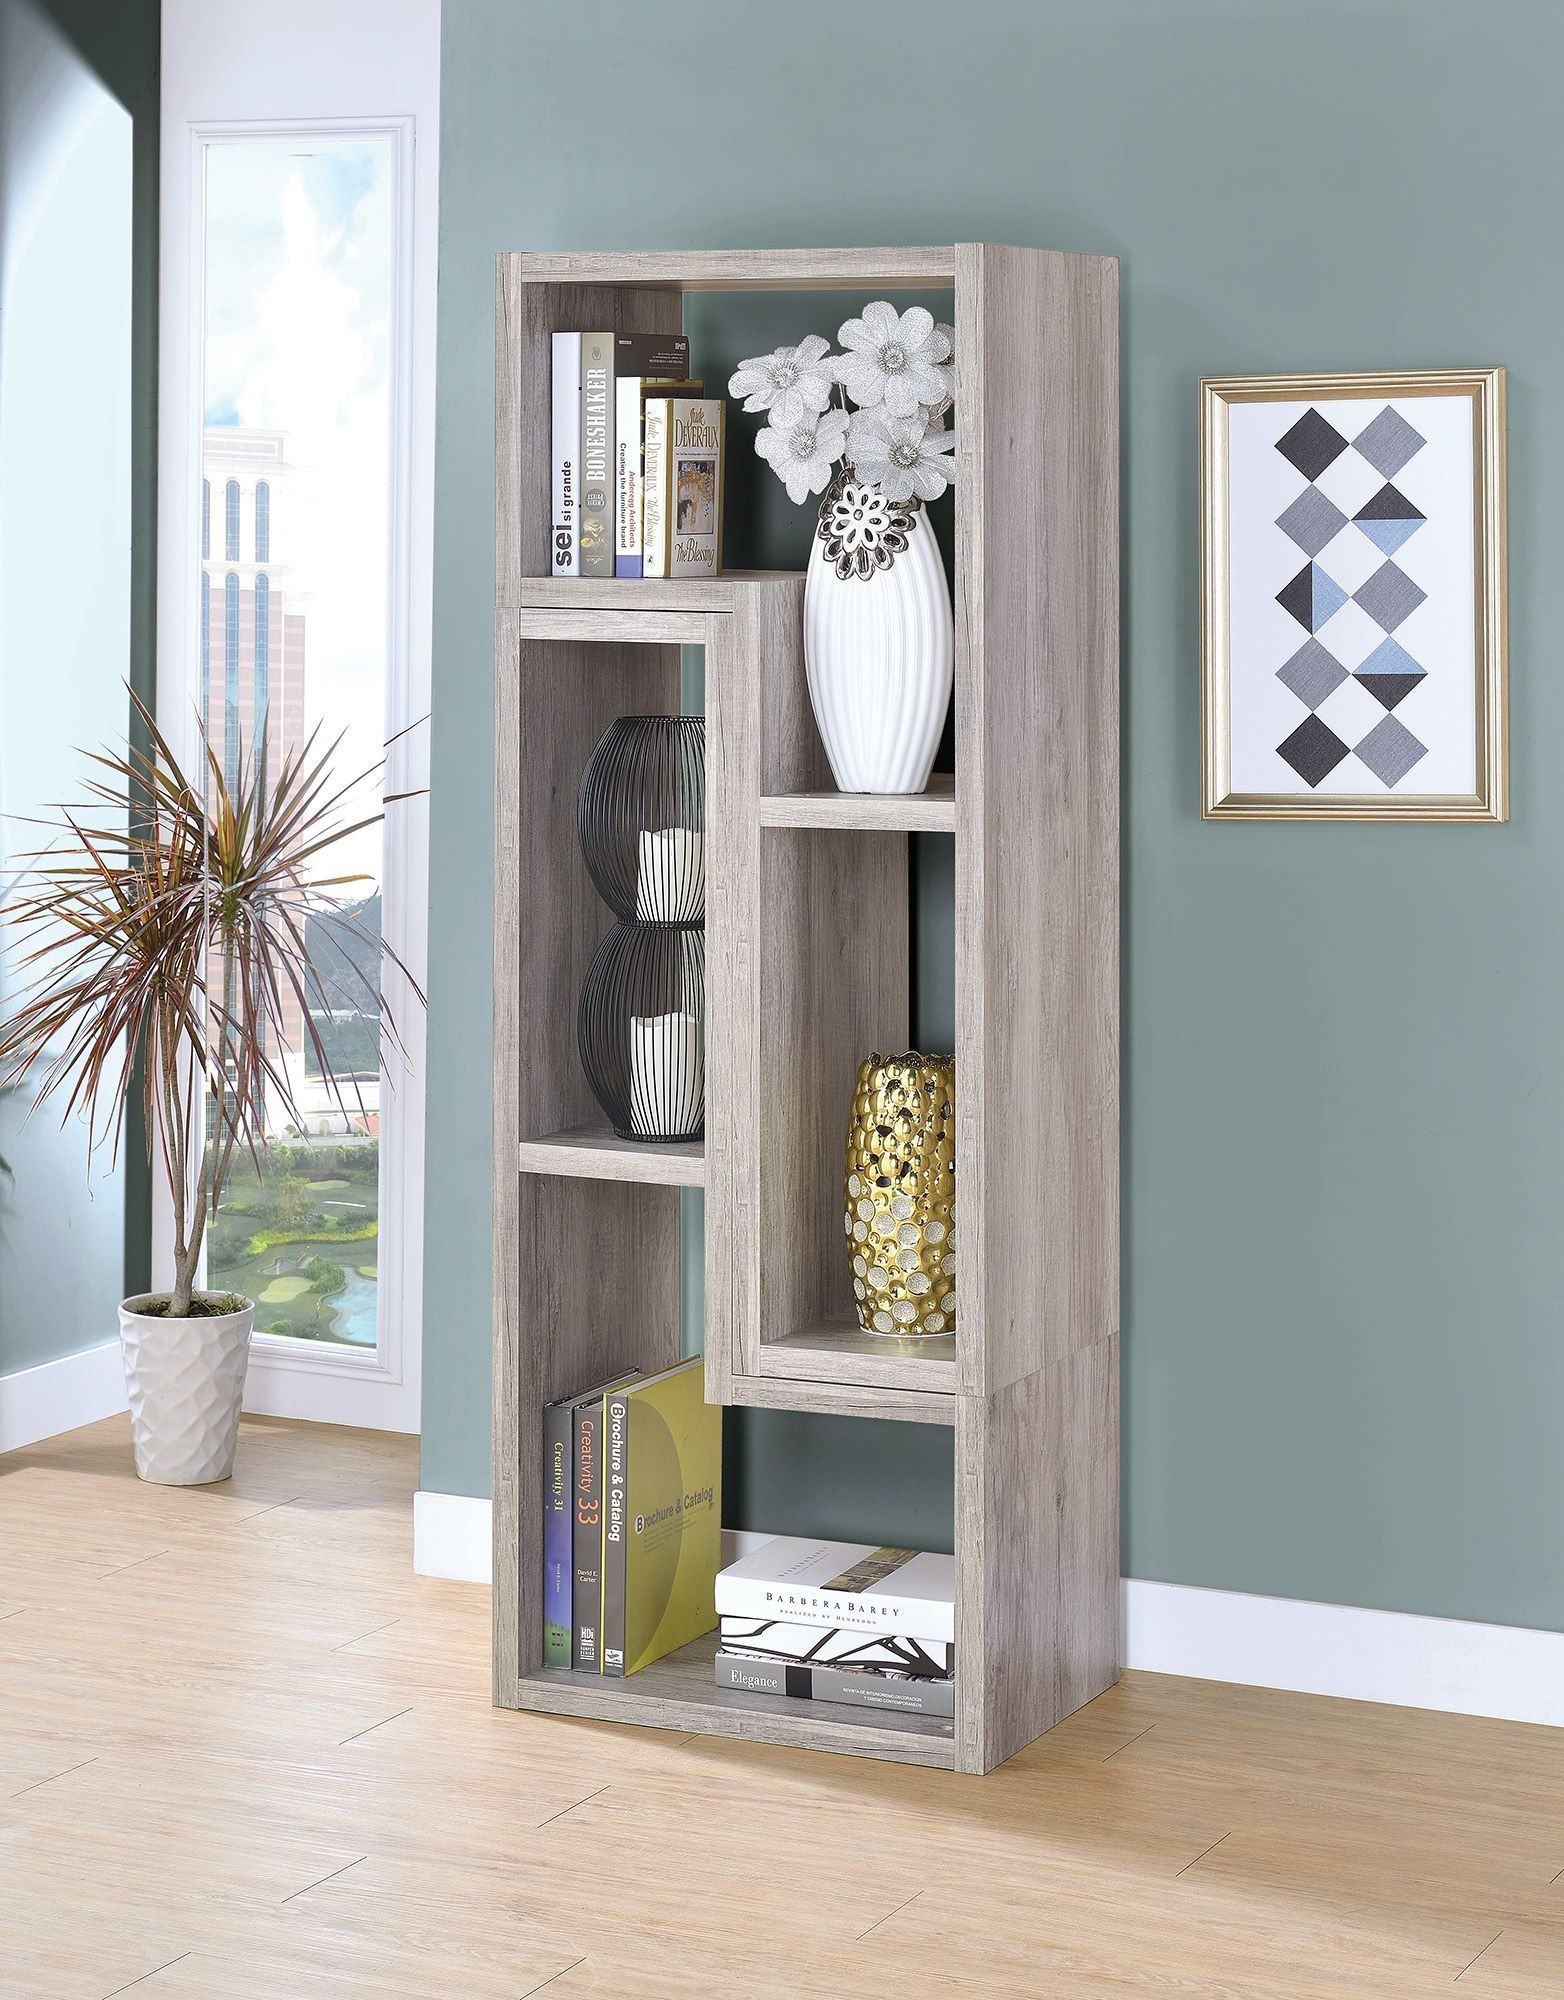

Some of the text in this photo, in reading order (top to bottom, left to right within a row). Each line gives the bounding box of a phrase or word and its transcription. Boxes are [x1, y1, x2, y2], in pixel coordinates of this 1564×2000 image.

[586, 368, 606, 481] BONESHAKER
[619, 443, 627, 476] Creating
[562, 461, 573, 507] grande
[561, 510, 571, 521] si
[687, 538, 714, 567] Blessing
[553, 1442, 564, 1511] Creativity 31
[578, 1420, 599, 1525] Creativity 33
[608, 1402, 626, 1542] Brochure & Catalog
[635, 1505, 674, 1534] Brochure
[684, 1487, 713, 1509] Catalog
[730, 1669, 778, 1689] Elegance
